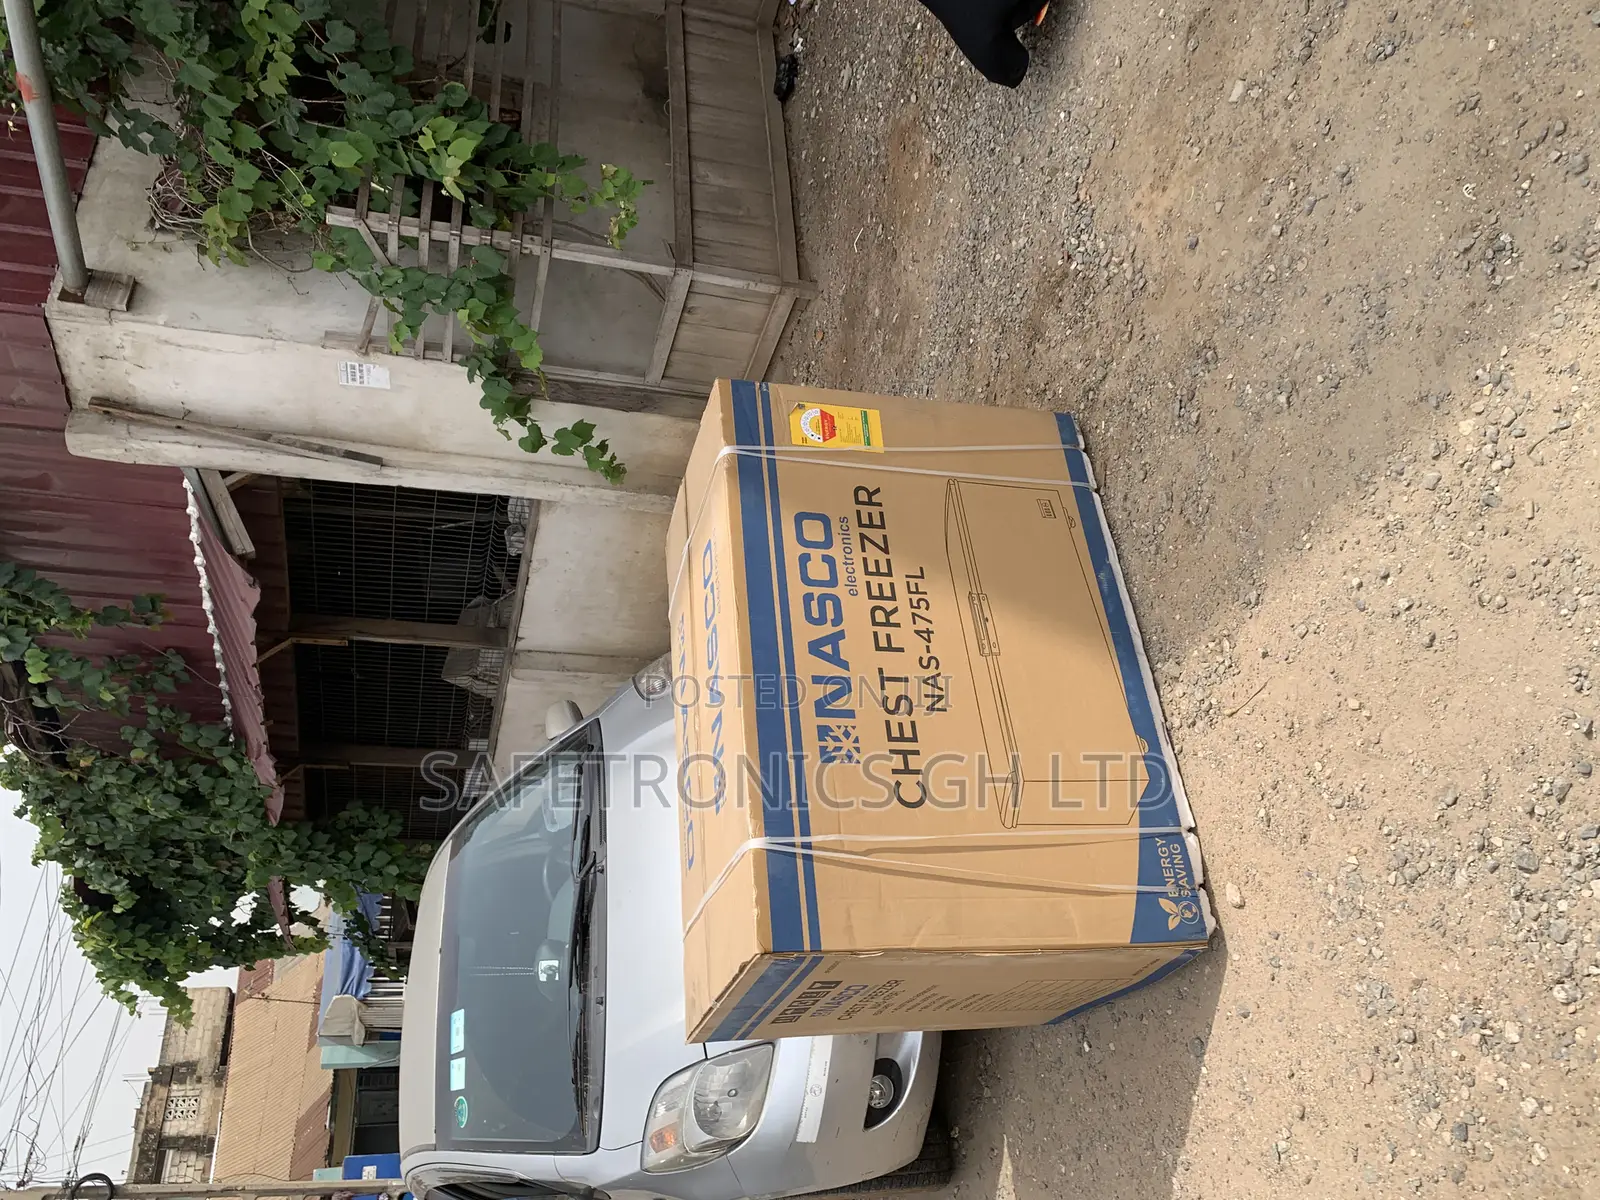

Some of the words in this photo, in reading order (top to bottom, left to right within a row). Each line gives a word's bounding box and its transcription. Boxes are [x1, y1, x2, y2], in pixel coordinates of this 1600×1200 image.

[836, 515, 859, 597] electronics
[852, 484, 906, 654] FREEZER
[702, 538, 724, 766] NASCO
[794, 511, 857, 720] NASCO
[905, 565, 949, 713] NAS-475FL
[877, 667, 928, 810] CHEST
[1155, 837, 1180, 898] ENERGY
[1170, 843, 1192, 898] SAVING
[815, 983, 870, 1012] NASCO
[836, 1001, 869, 1021] CHEST
